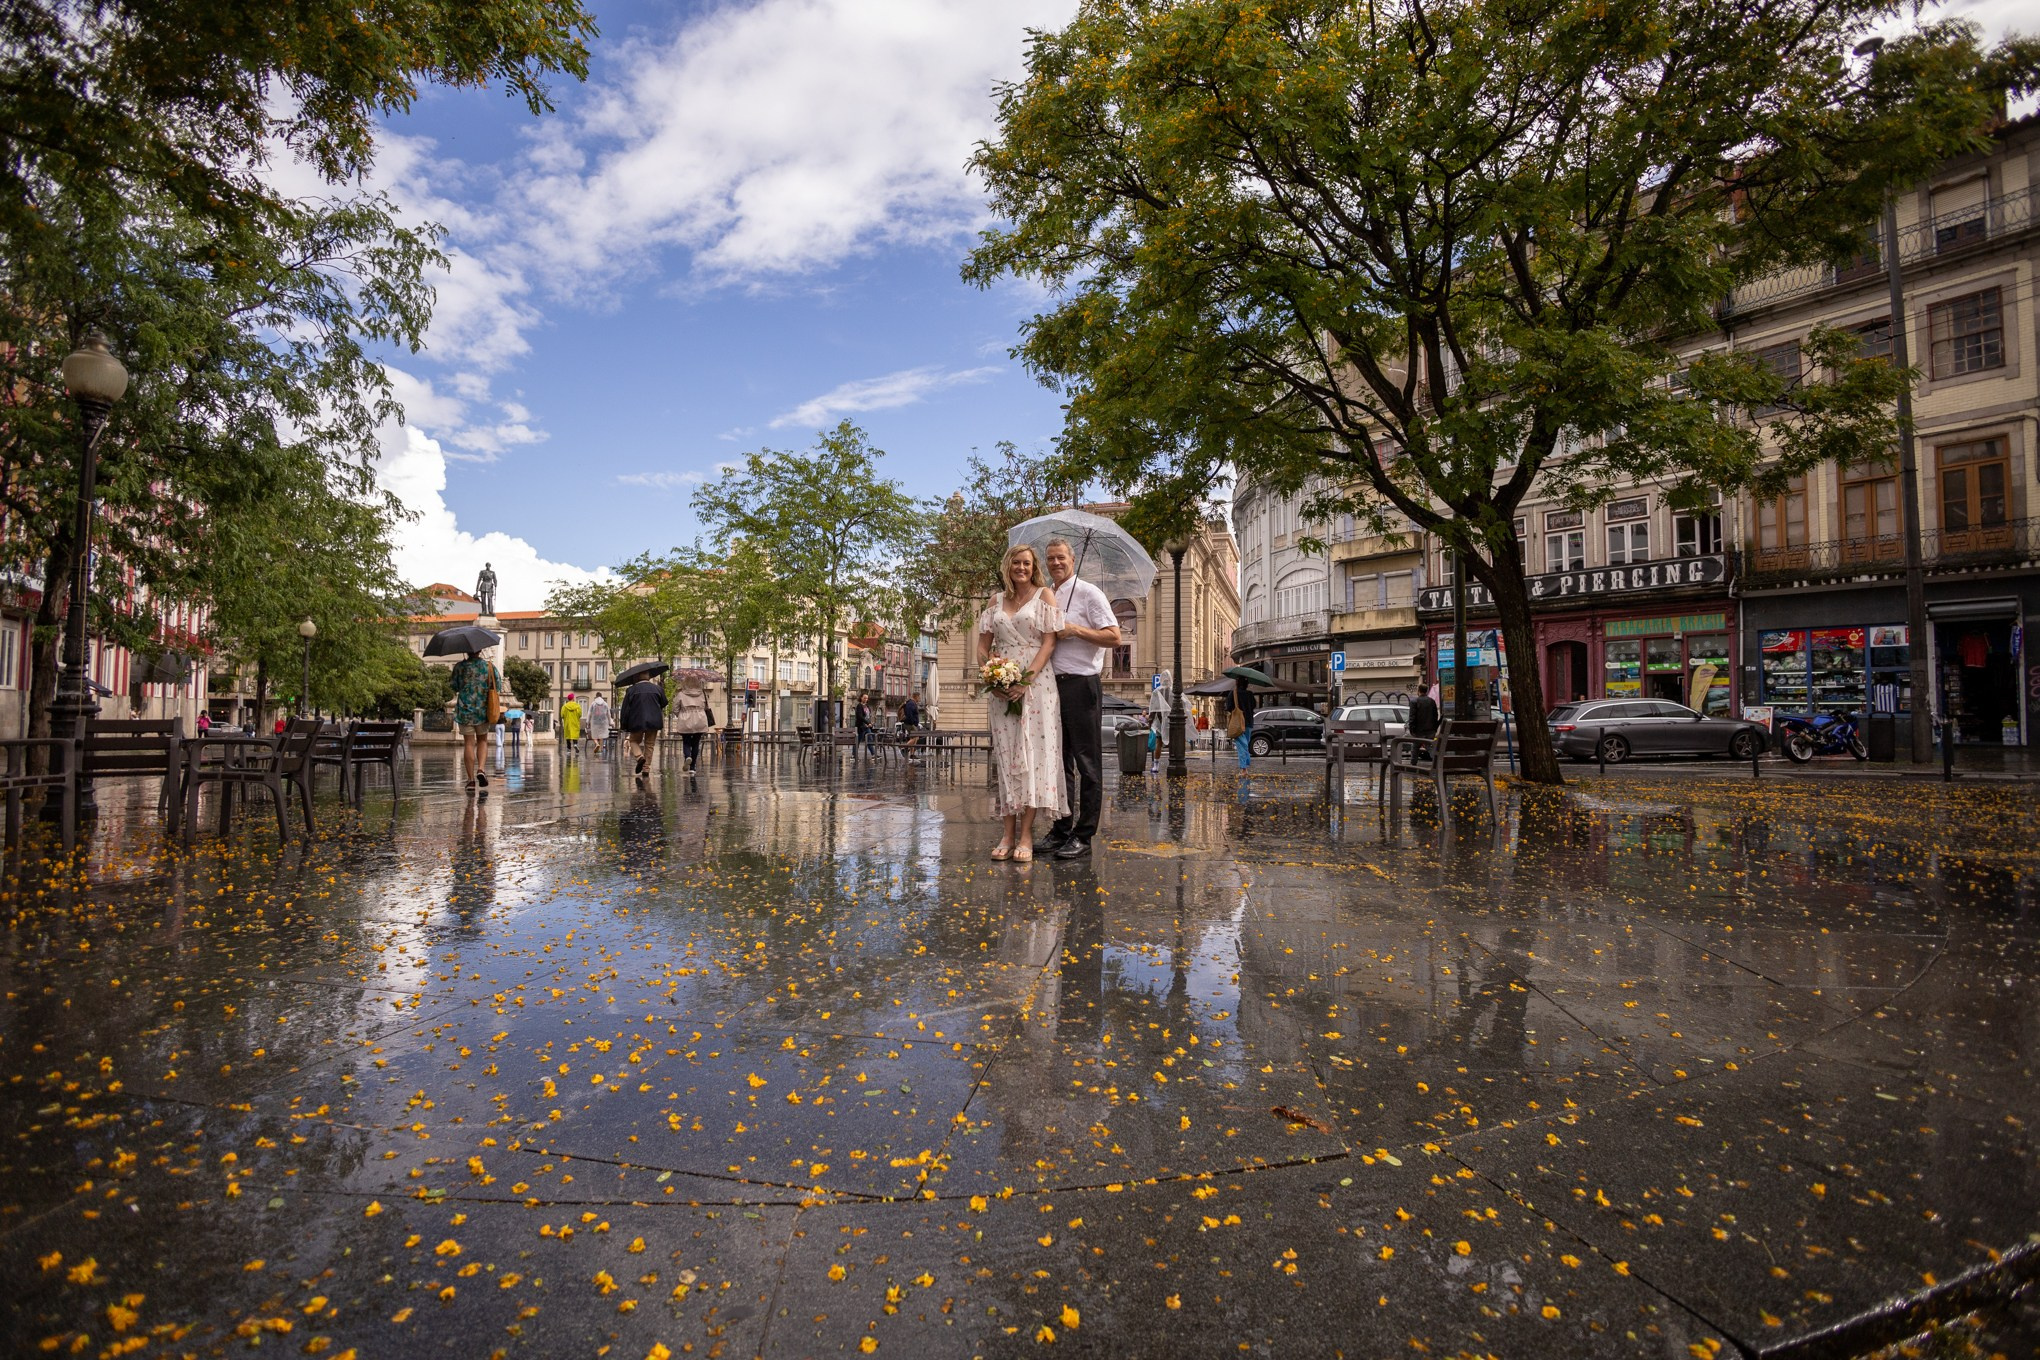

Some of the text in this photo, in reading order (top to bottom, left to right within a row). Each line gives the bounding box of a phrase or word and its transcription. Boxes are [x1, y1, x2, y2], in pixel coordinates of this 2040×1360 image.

[1429, 561, 1705, 609] TAT & PIERCING
[1680, 613, 1725, 633] BRASIL
[1334, 654, 1343, 669] P
[1154, 675, 1161, 688] P
